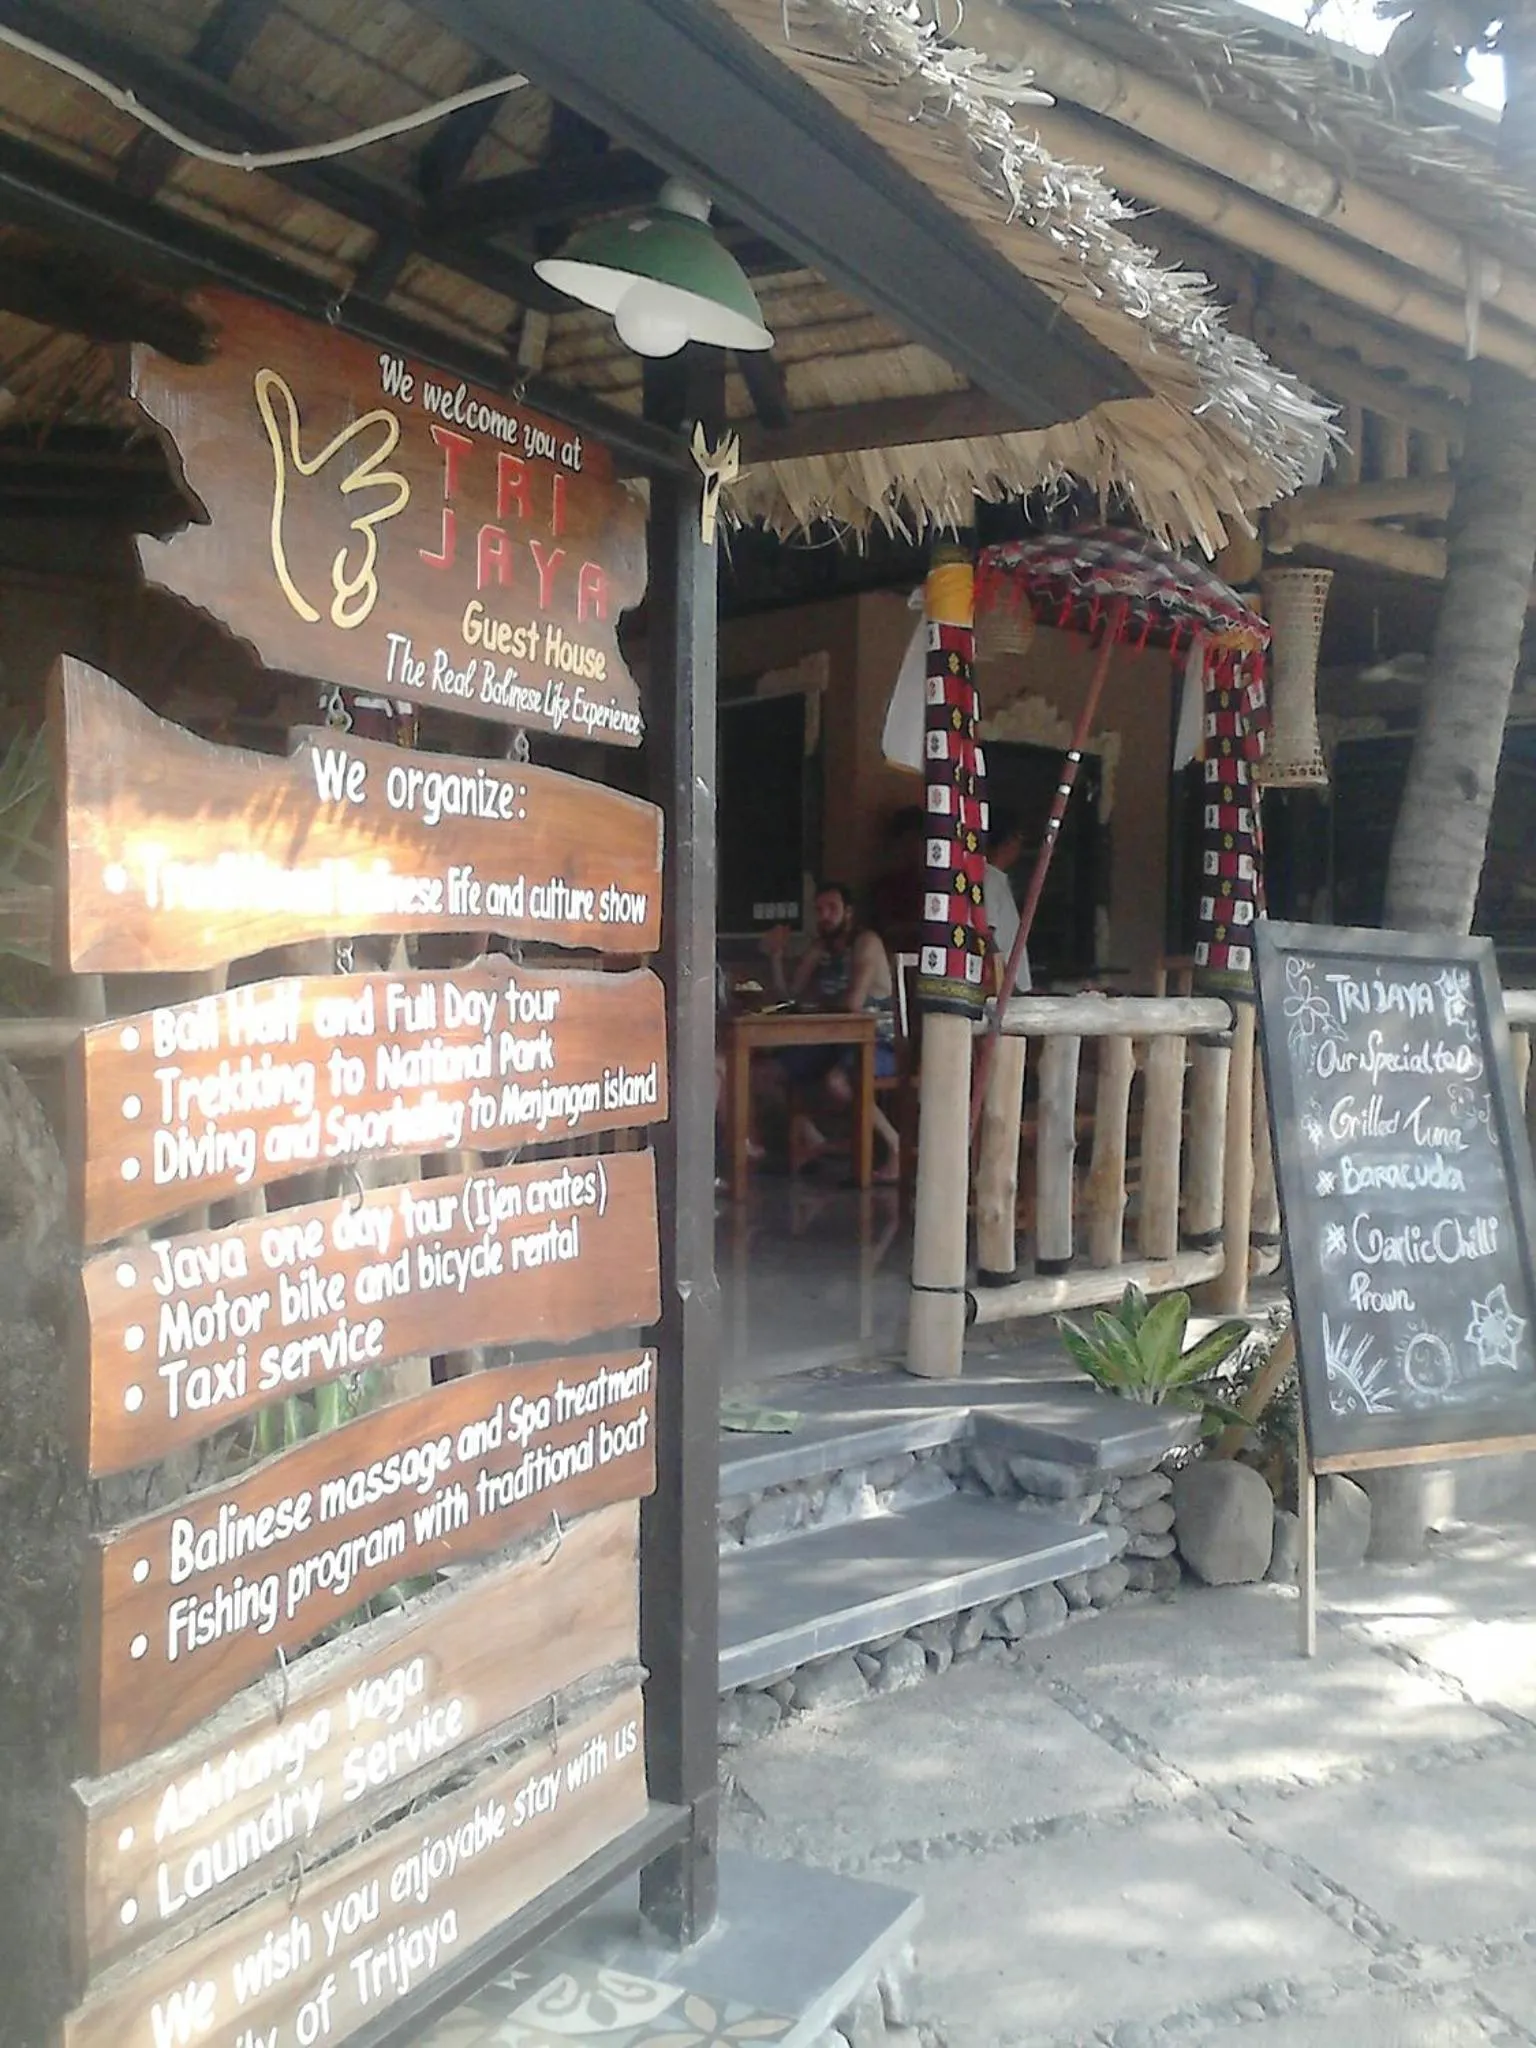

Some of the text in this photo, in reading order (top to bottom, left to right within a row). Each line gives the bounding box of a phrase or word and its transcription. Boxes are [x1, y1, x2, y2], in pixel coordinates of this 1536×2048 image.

[379, 353, 582, 471] We welcome you at
[430, 423, 567, 536] TRI
[419, 507, 609, 623] JAYA
[386, 633, 645, 735] The Real Balinese Life Experience
[462, 600, 607, 681] Guest House
[312, 747, 528, 825] We organize:
[448, 865, 480, 916] life
[486, 875, 525, 918] and
[530, 878, 594, 922] culture
[600, 883, 647, 924] show
[314, 984, 375, 1038] and
[386, 982, 436, 1032] Full
[444, 982, 498, 1034] Day
[505, 978, 560, 1024] tour
[1316, 1039, 1358, 1078] Our
[153, 1029, 555, 1124] Trekking to National Park
[153, 1121, 256, 1185] Diving
[264, 1110, 320, 1162] and
[469, 1086, 497, 1131] to
[604, 1062, 658, 1110] island
[1328, 1095, 1470, 1150] Grilled Tuna
[151, 1160, 607, 1296] Java one day tour (Ijen crates)
[1352, 1213, 1499, 1266] Garlic Chilli
[158, 1214, 580, 1357] Motor bike and bicycle rental
[159, 1317, 384, 1419] Taxi service
[170, 1351, 652, 1585] Balinese massage and Spa treatment
[169, 1406, 648, 1662] Fishing program with traditional boat
[154, 1658, 424, 1843] Ashtanga yoga
[151, 1721, 637, 2048] We wish you enjoyable stay with us
[157, 1779, 323, 1918] Laundry
[296, 1909, 457, 2046] of Trijaya
